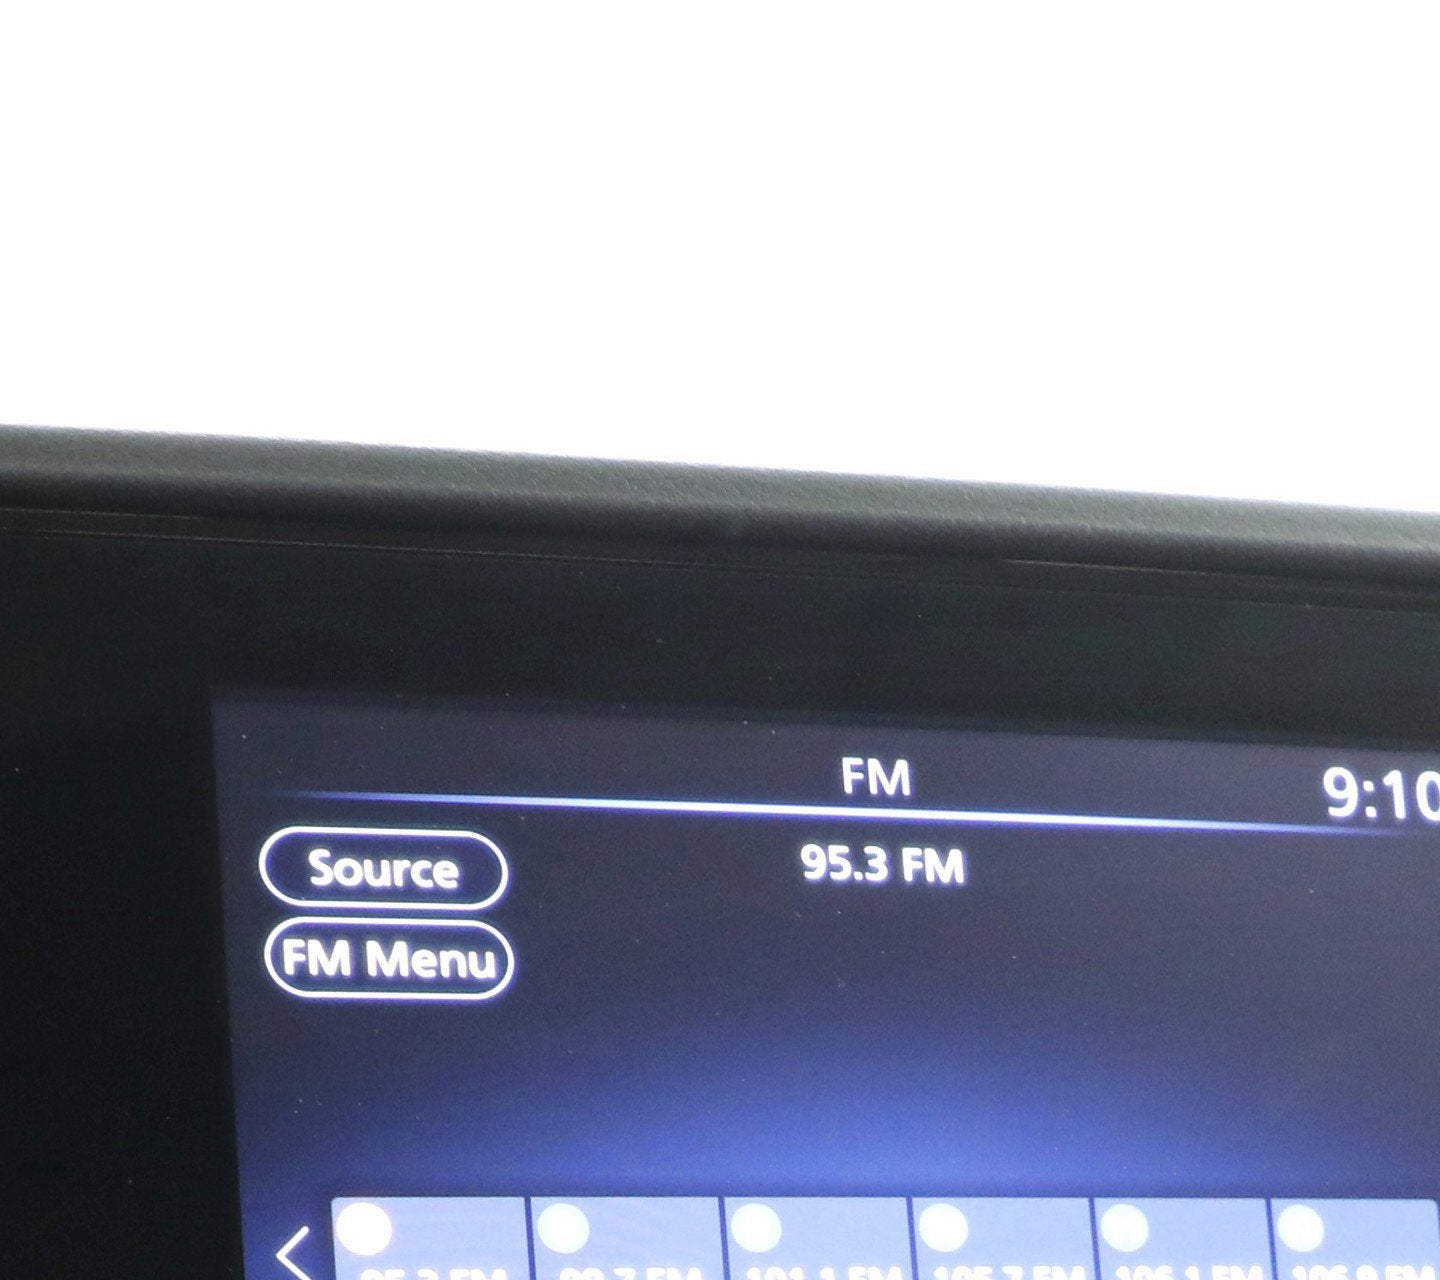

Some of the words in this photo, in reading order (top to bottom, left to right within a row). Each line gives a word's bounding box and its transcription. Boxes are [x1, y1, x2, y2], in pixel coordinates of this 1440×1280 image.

[842, 757, 911, 796] FM
[308, 849, 459, 889] Source
[800, 844, 888, 881] 95.3
[903, 847, 964, 884] FM
[282, 939, 350, 976] FM
[366, 941, 496, 979] Menu
